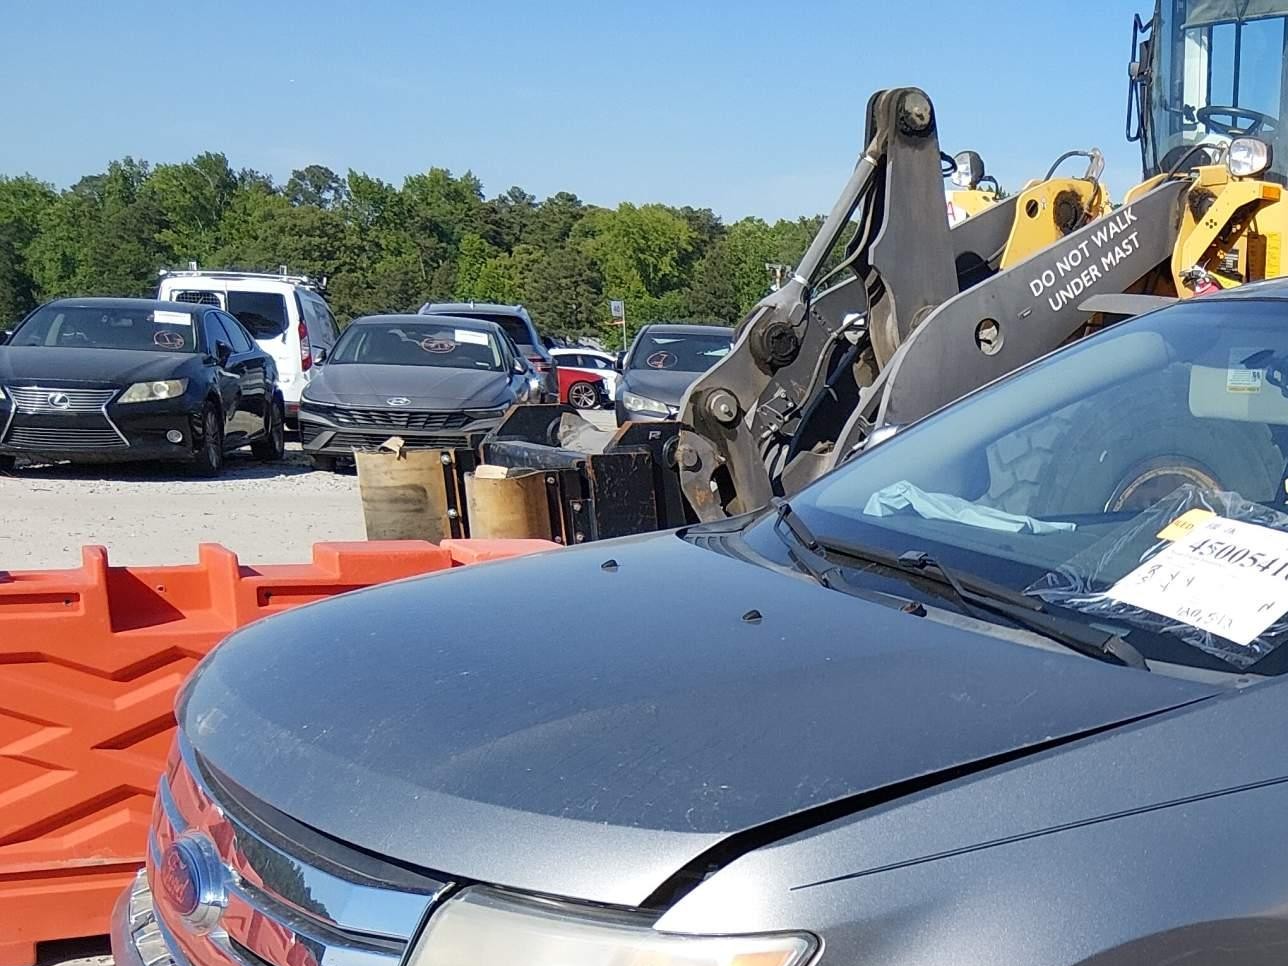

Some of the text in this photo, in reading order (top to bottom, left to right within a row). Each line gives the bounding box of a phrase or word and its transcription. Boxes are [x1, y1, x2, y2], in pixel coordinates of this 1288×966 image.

[1029, 206, 1137, 297] DO NOT WALK
[1048, 231, 1139, 311] UNDER MAST
